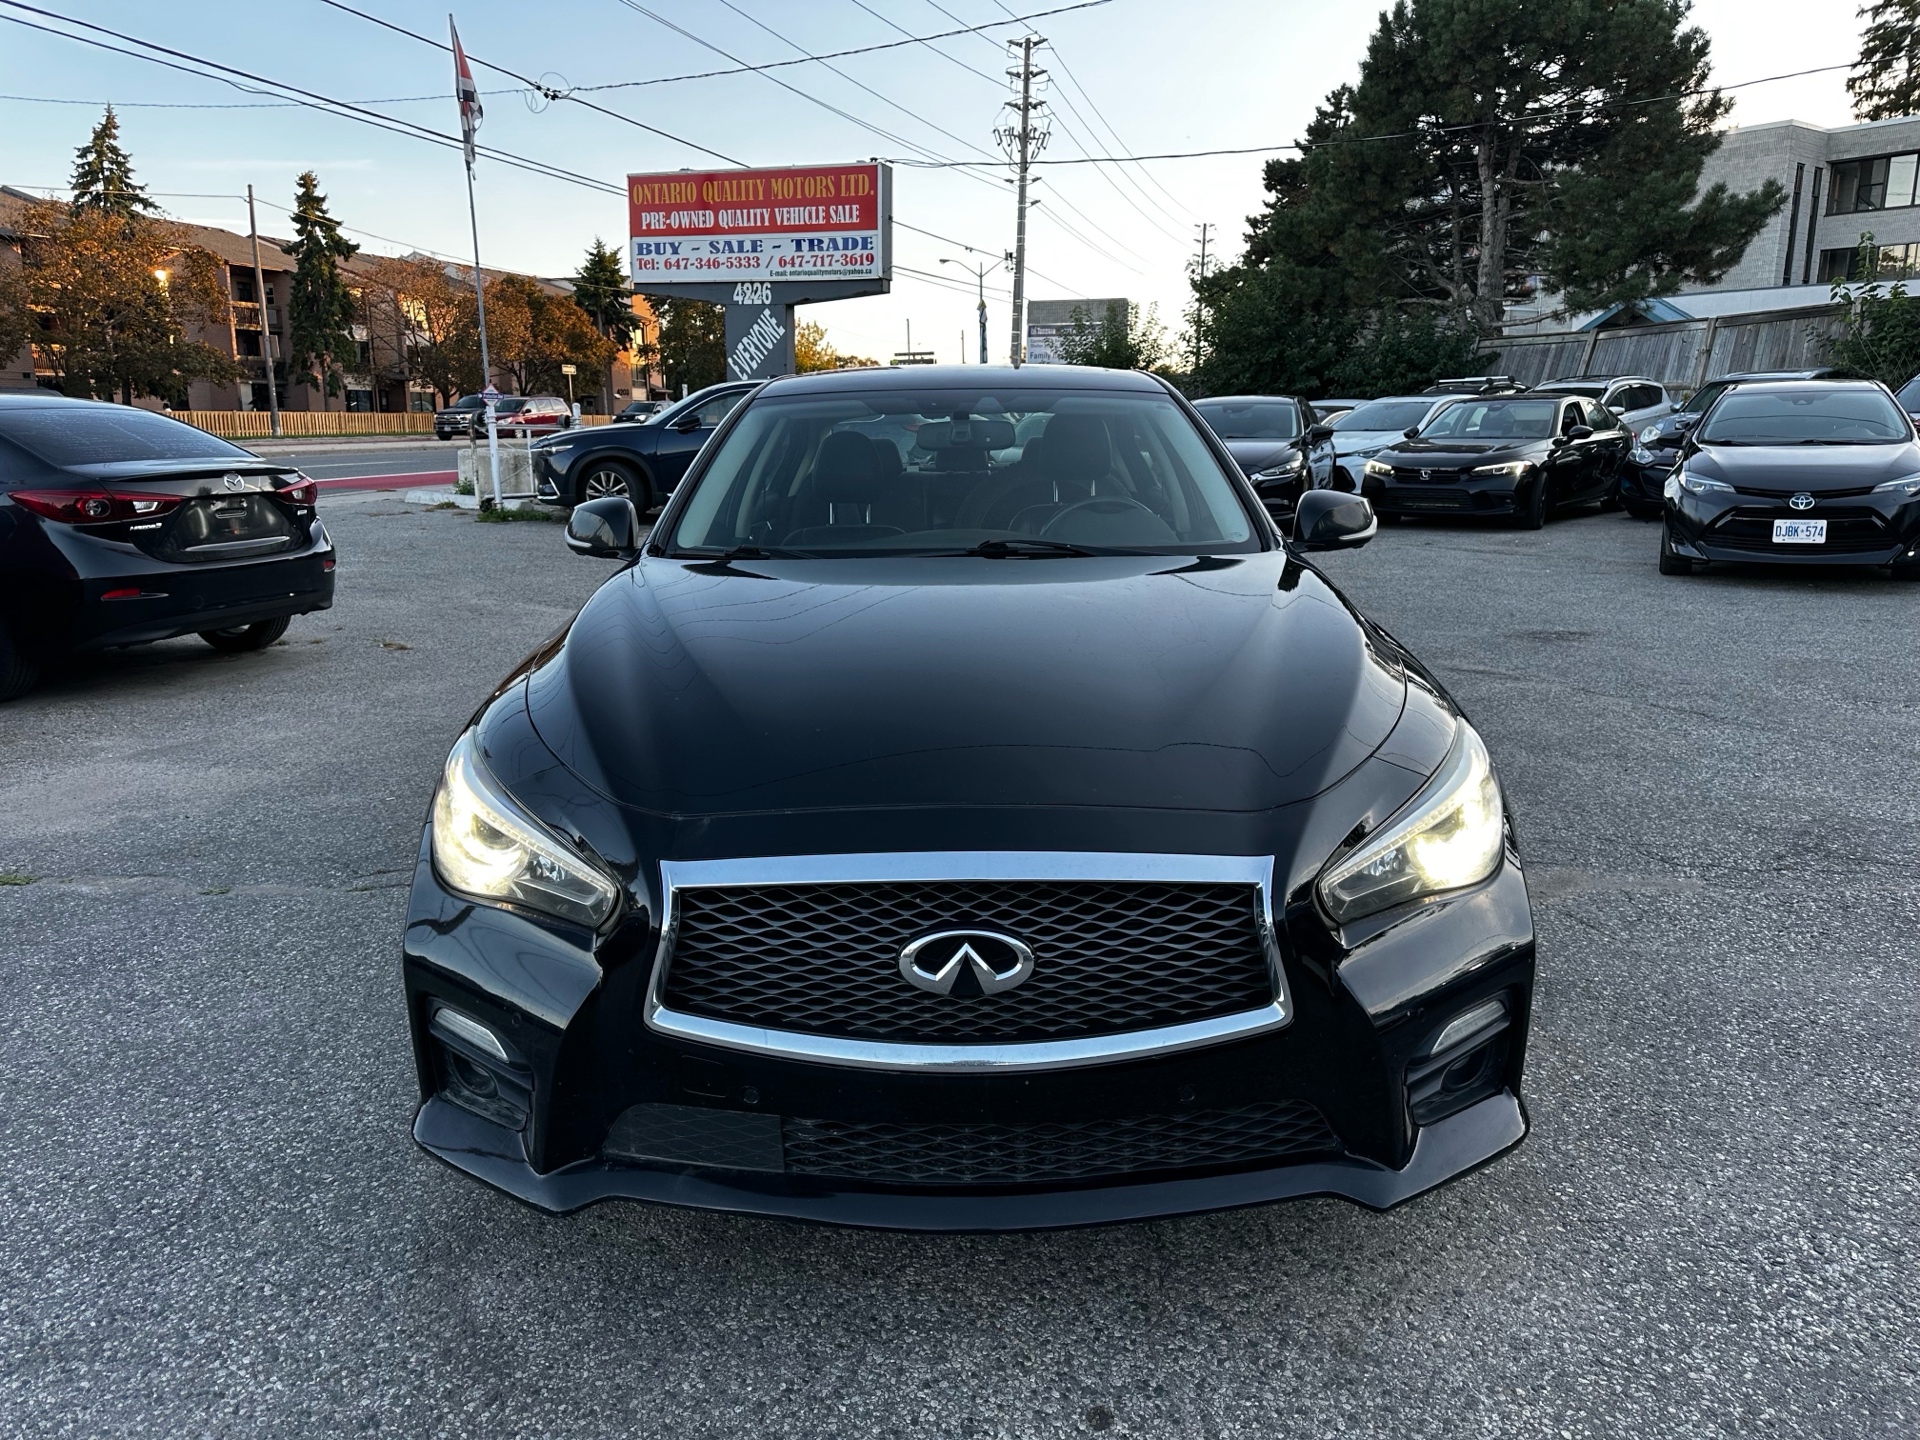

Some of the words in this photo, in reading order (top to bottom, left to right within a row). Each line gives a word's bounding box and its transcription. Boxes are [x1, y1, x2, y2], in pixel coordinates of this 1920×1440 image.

[632, 182, 697, 205] ONTARIO
[702, 179, 766, 204] QUALITY
[771, 175, 835, 199] MOTORS
[840, 173, 875, 197] LTD.
[641, 210, 714, 230] PRE-OWNED
[718, 208, 771, 229] QUALITY
[774, 206, 826, 226] VEHICLE
[829, 204, 860, 224] SALE
[636, 241, 682, 256] BUY
[709, 239, 763, 254] SALE
[791, 236, 874, 253] TRADE
[636, 258, 660, 271] Tel:
[664, 255, 761, 270] 647-346-5333
[778, 253, 875, 268] 647-717-3619
[733, 282, 772, 305] 4226
[727, 308, 786, 380] EVERYONE
[1030, 351, 1051, 360] Family
